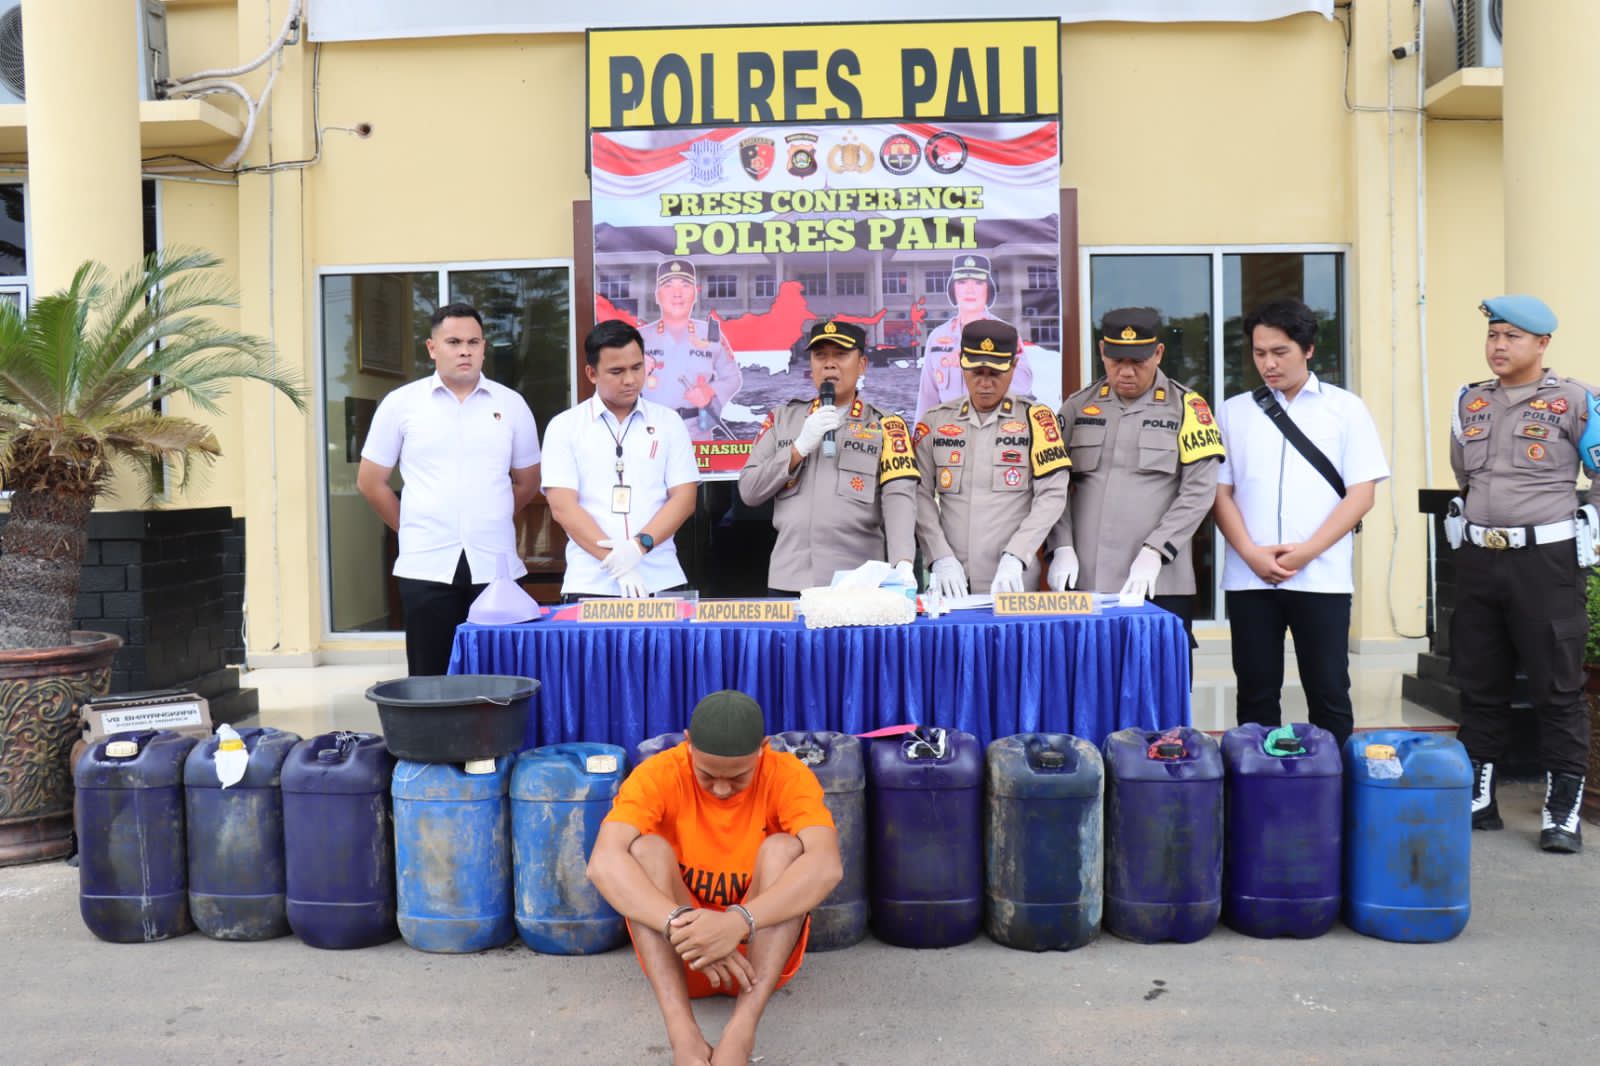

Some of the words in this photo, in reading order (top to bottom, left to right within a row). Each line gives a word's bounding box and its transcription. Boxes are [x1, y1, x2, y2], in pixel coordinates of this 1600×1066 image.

[608, 48, 864, 127] POLRES
[901, 45, 1038, 119] PALI
[660, 190, 764, 217] PRESS
[769, 186, 984, 214] CONFERENCE
[673, 217, 856, 256] POLRES
[868, 215, 979, 251] PALI
[1142, 419, 1179, 431] POLRI
[1522, 410, 1561, 424] POLRI
[843, 440, 878, 455] POLRI
[932, 437, 966, 447] HENDRO
[995, 436, 1030, 447] POLRI
[582, 602, 634, 619] BARANG
[637, 602, 676, 619] BUKTI
[699, 603, 761, 620] KAPOLRES
[764, 603, 790, 620] PALI
[999, 595, 1090, 612] TERSANGKA
